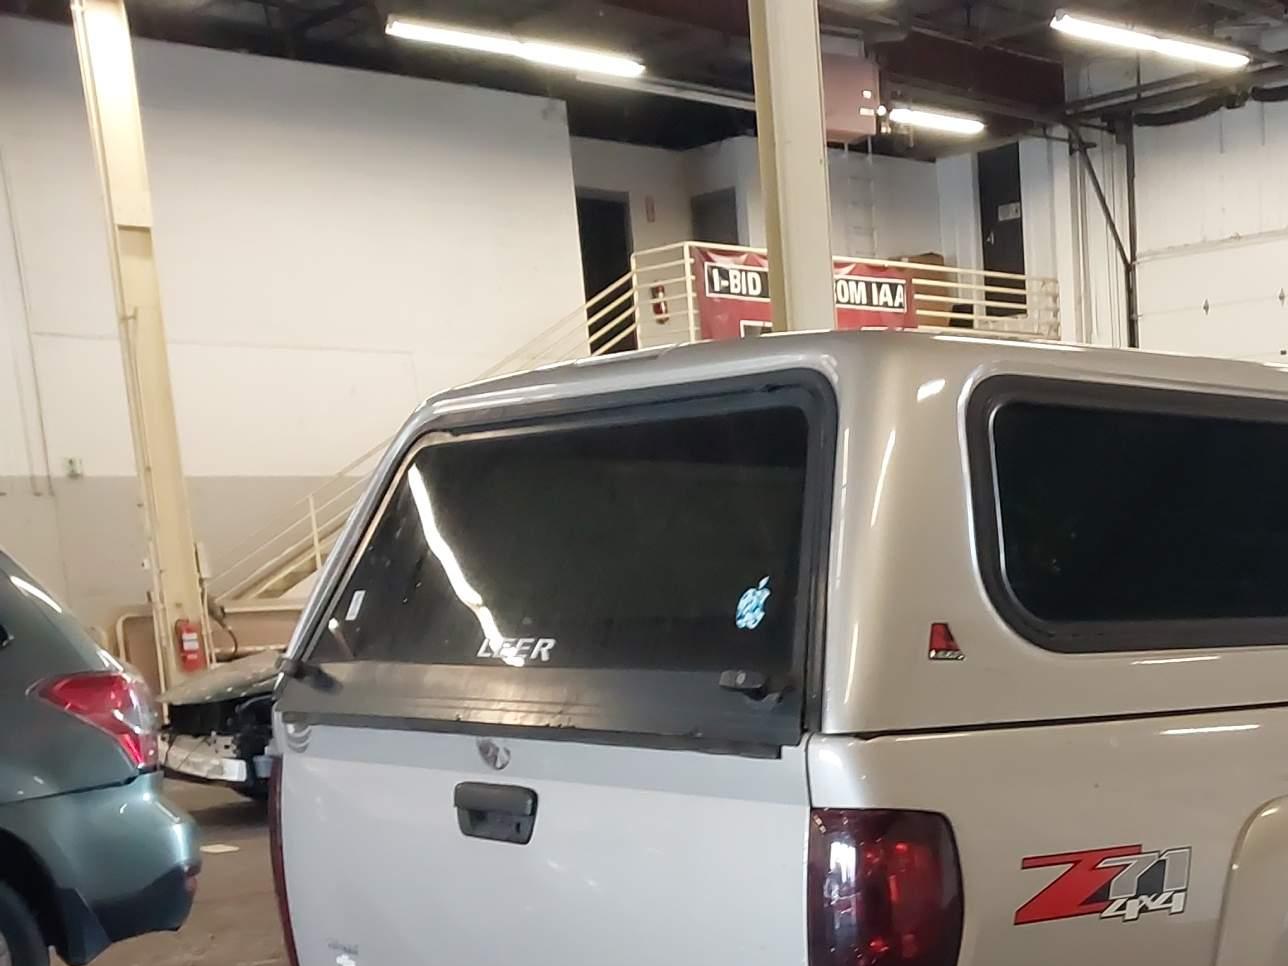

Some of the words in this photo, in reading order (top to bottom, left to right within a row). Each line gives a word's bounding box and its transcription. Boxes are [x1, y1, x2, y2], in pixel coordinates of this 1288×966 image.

[712, 268, 762, 296] I-BID
[834, 279, 867, 305] OM
[871, 282, 905, 307] IAA
[476, 637, 556, 662] LEER
[1013, 843, 1192, 926] Z71
